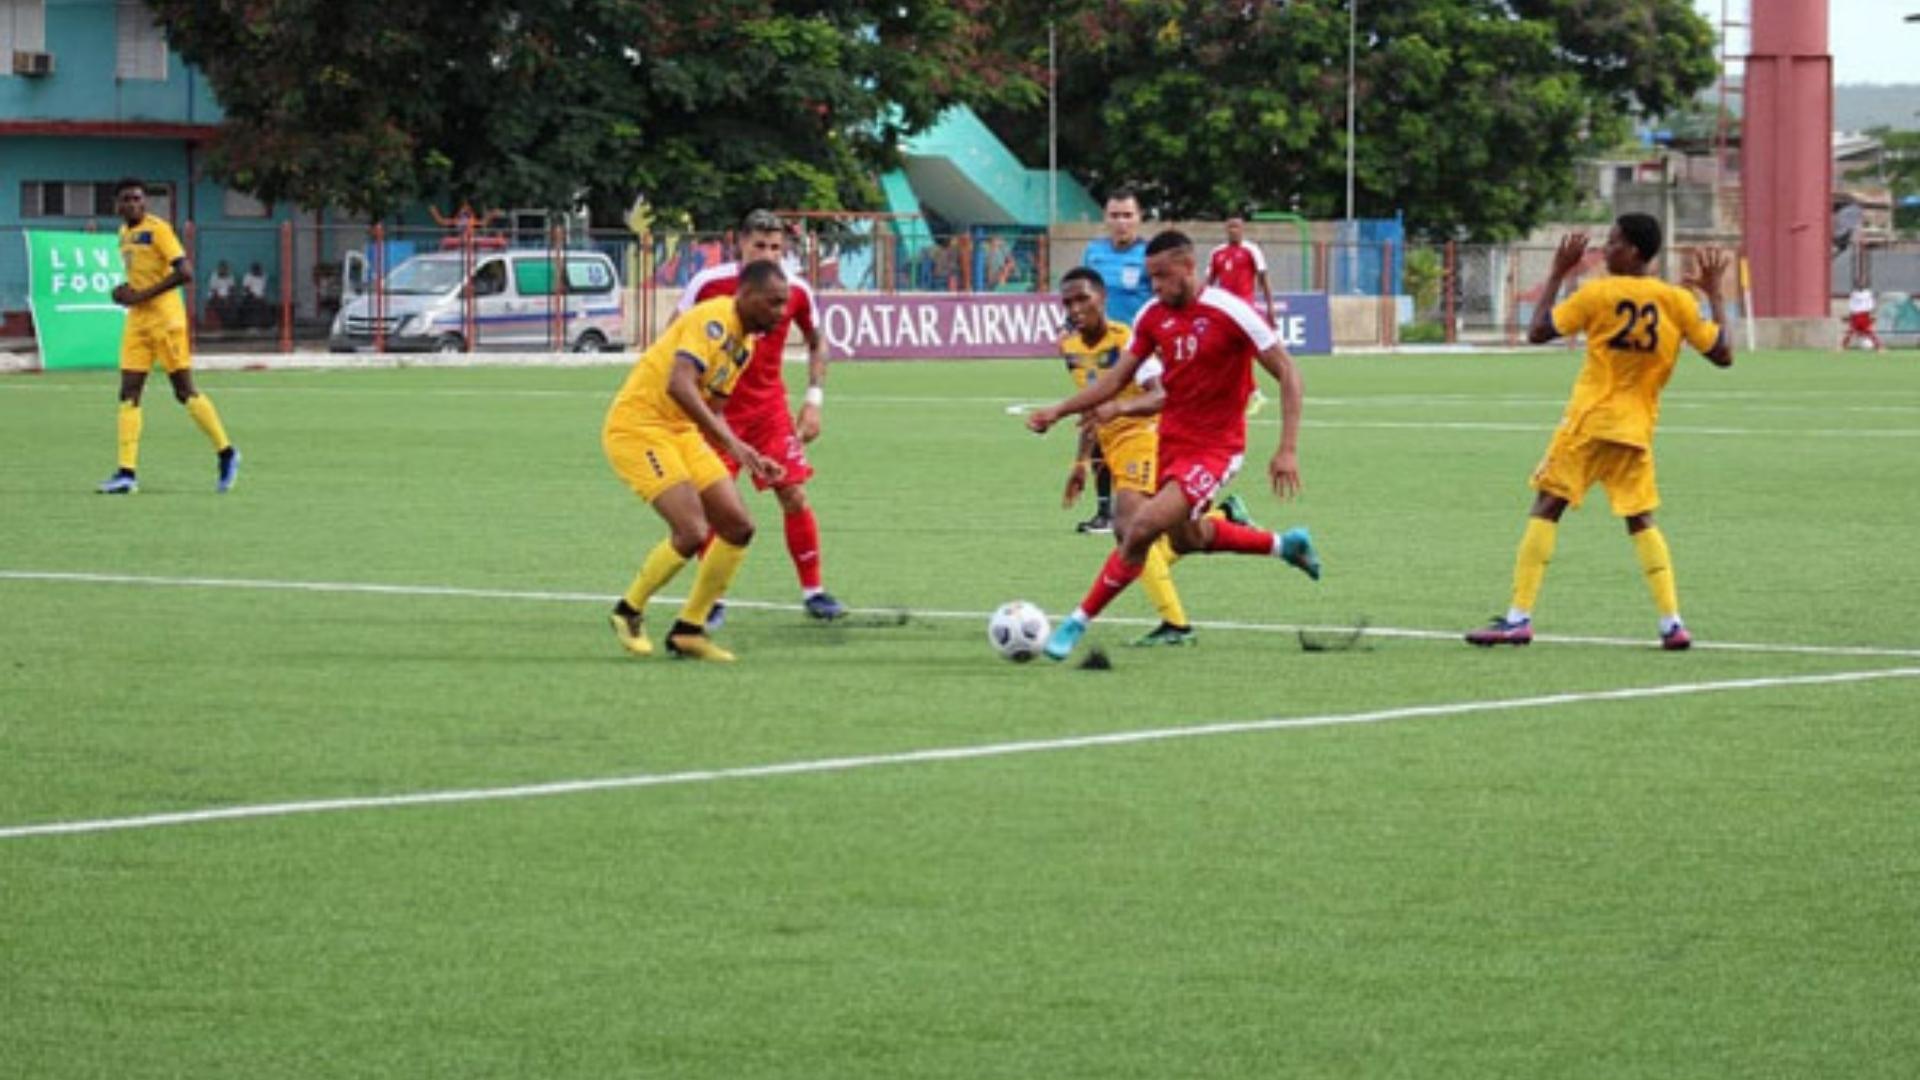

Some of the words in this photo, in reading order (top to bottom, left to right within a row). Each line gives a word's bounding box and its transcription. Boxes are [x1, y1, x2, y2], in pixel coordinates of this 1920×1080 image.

[50, 247, 109, 269] LIV
[51, 272, 121, 295] FOOT
[825, 303, 942, 356] QATAR
[949, 302, 1067, 345] AIRWAY
[1275, 315, 1306, 345] LE
[1608, 299, 1660, 354] 23
[1173, 335, 1198, 361] 19
